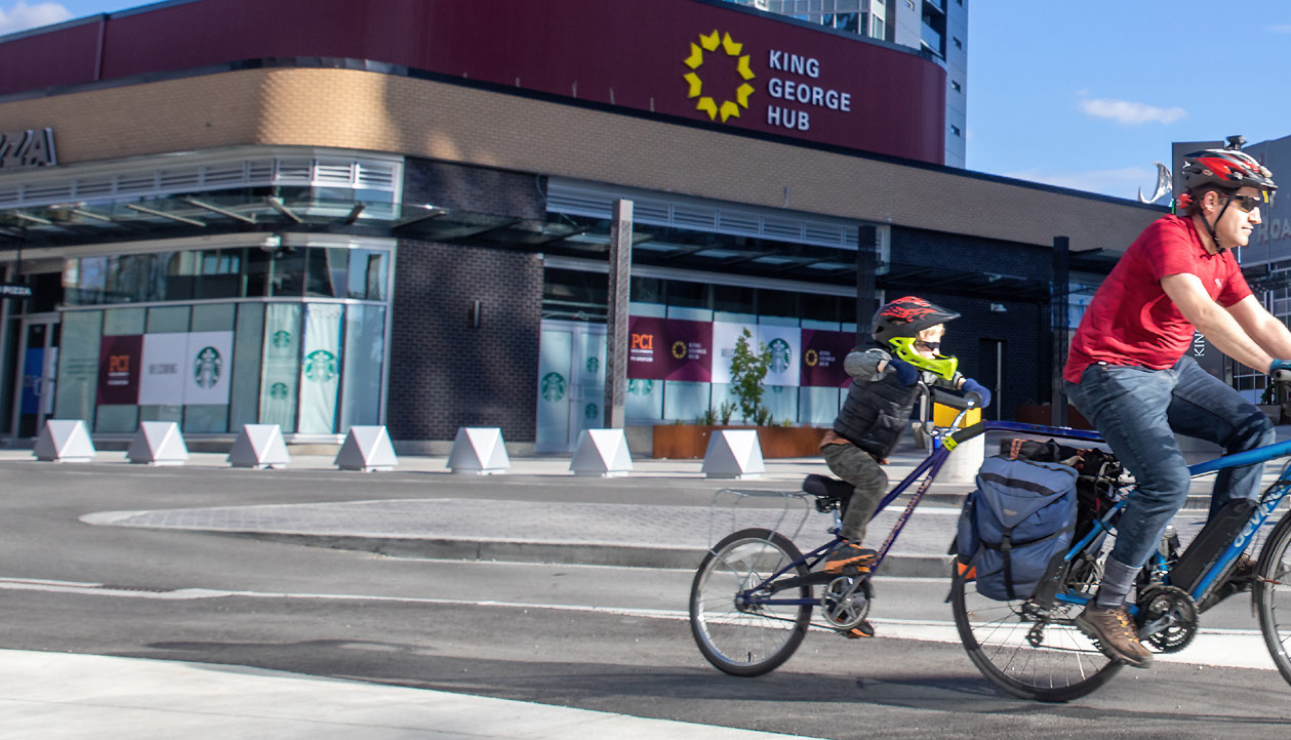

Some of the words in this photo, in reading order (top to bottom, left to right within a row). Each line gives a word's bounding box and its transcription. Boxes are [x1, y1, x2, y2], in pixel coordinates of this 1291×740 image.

[769, 49, 820, 79] KING
[768, 77, 851, 112] GEORGE
[767, 105, 810, 131] HUB
[631, 334, 654, 349] PCI
[1194, 329, 1205, 357] KIN
[109, 355, 130, 372] PCI
